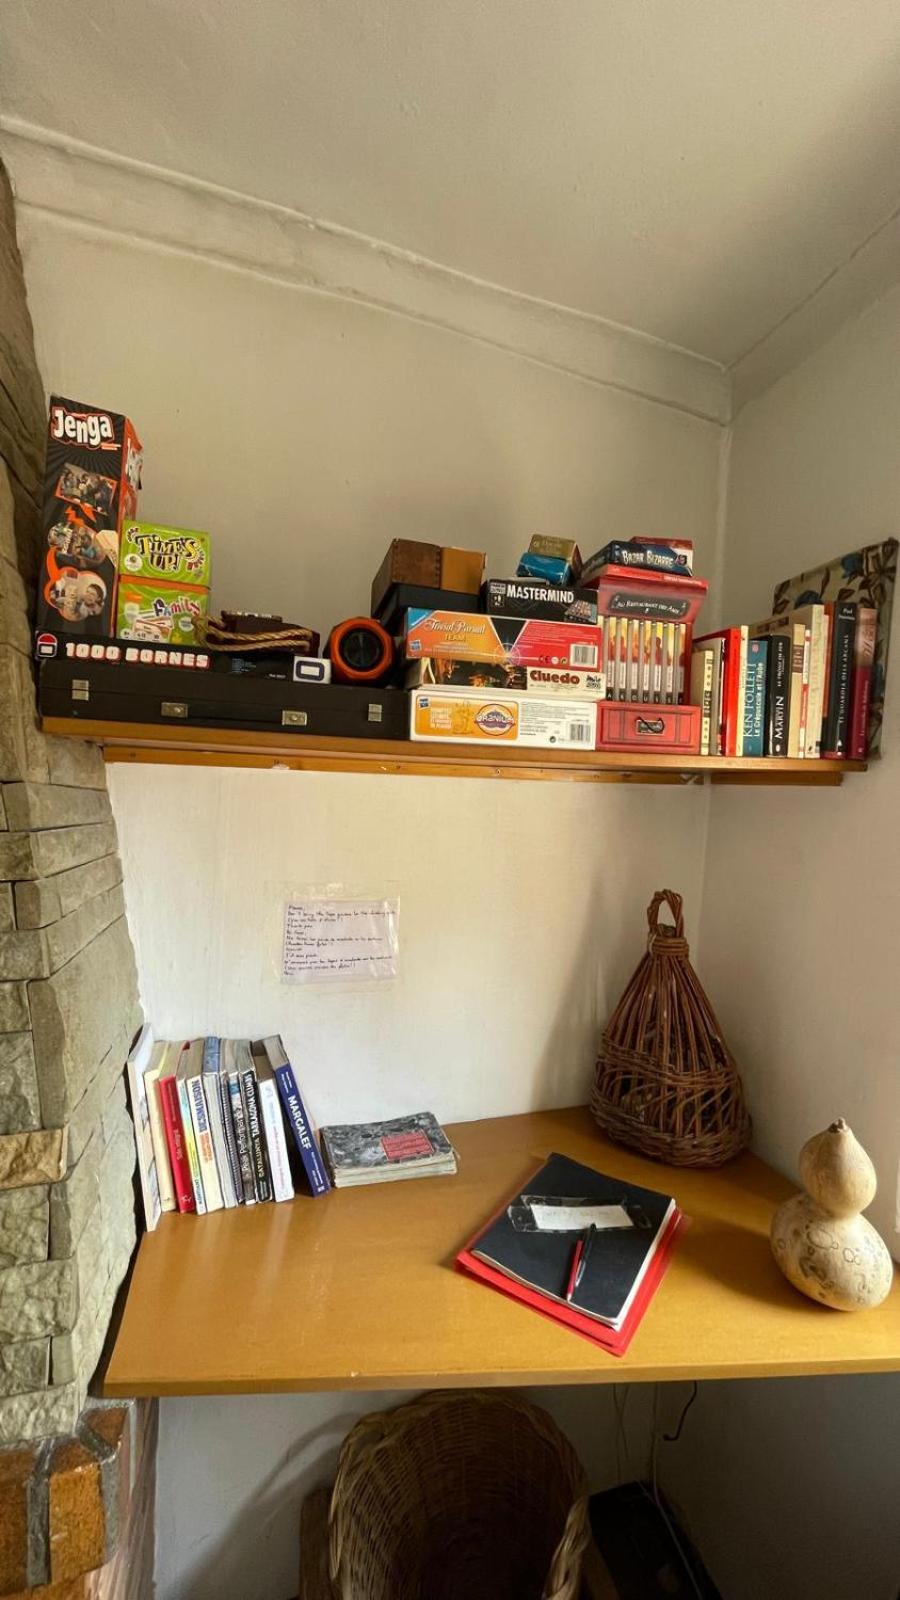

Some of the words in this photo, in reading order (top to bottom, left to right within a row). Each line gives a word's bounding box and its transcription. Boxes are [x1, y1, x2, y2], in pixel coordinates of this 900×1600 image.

[54, 409, 113, 447] Jenga
[150, 553, 180, 571] UP!
[622, 549, 645, 566] BAZAR
[646, 550, 674, 567] BIZARRE
[506, 583, 575, 604] MASTERMIND
[65, 641, 121, 661] 1000
[125, 647, 211, 670] BORNES
[529, 669, 581, 685] Cluedo
[744, 663, 757, 706] FOLLETT
[742, 707, 755, 738] KEN
[246, 1098, 260, 1141] TARRAGONA
[286, 1096, 312, 1151] MARGALEF
